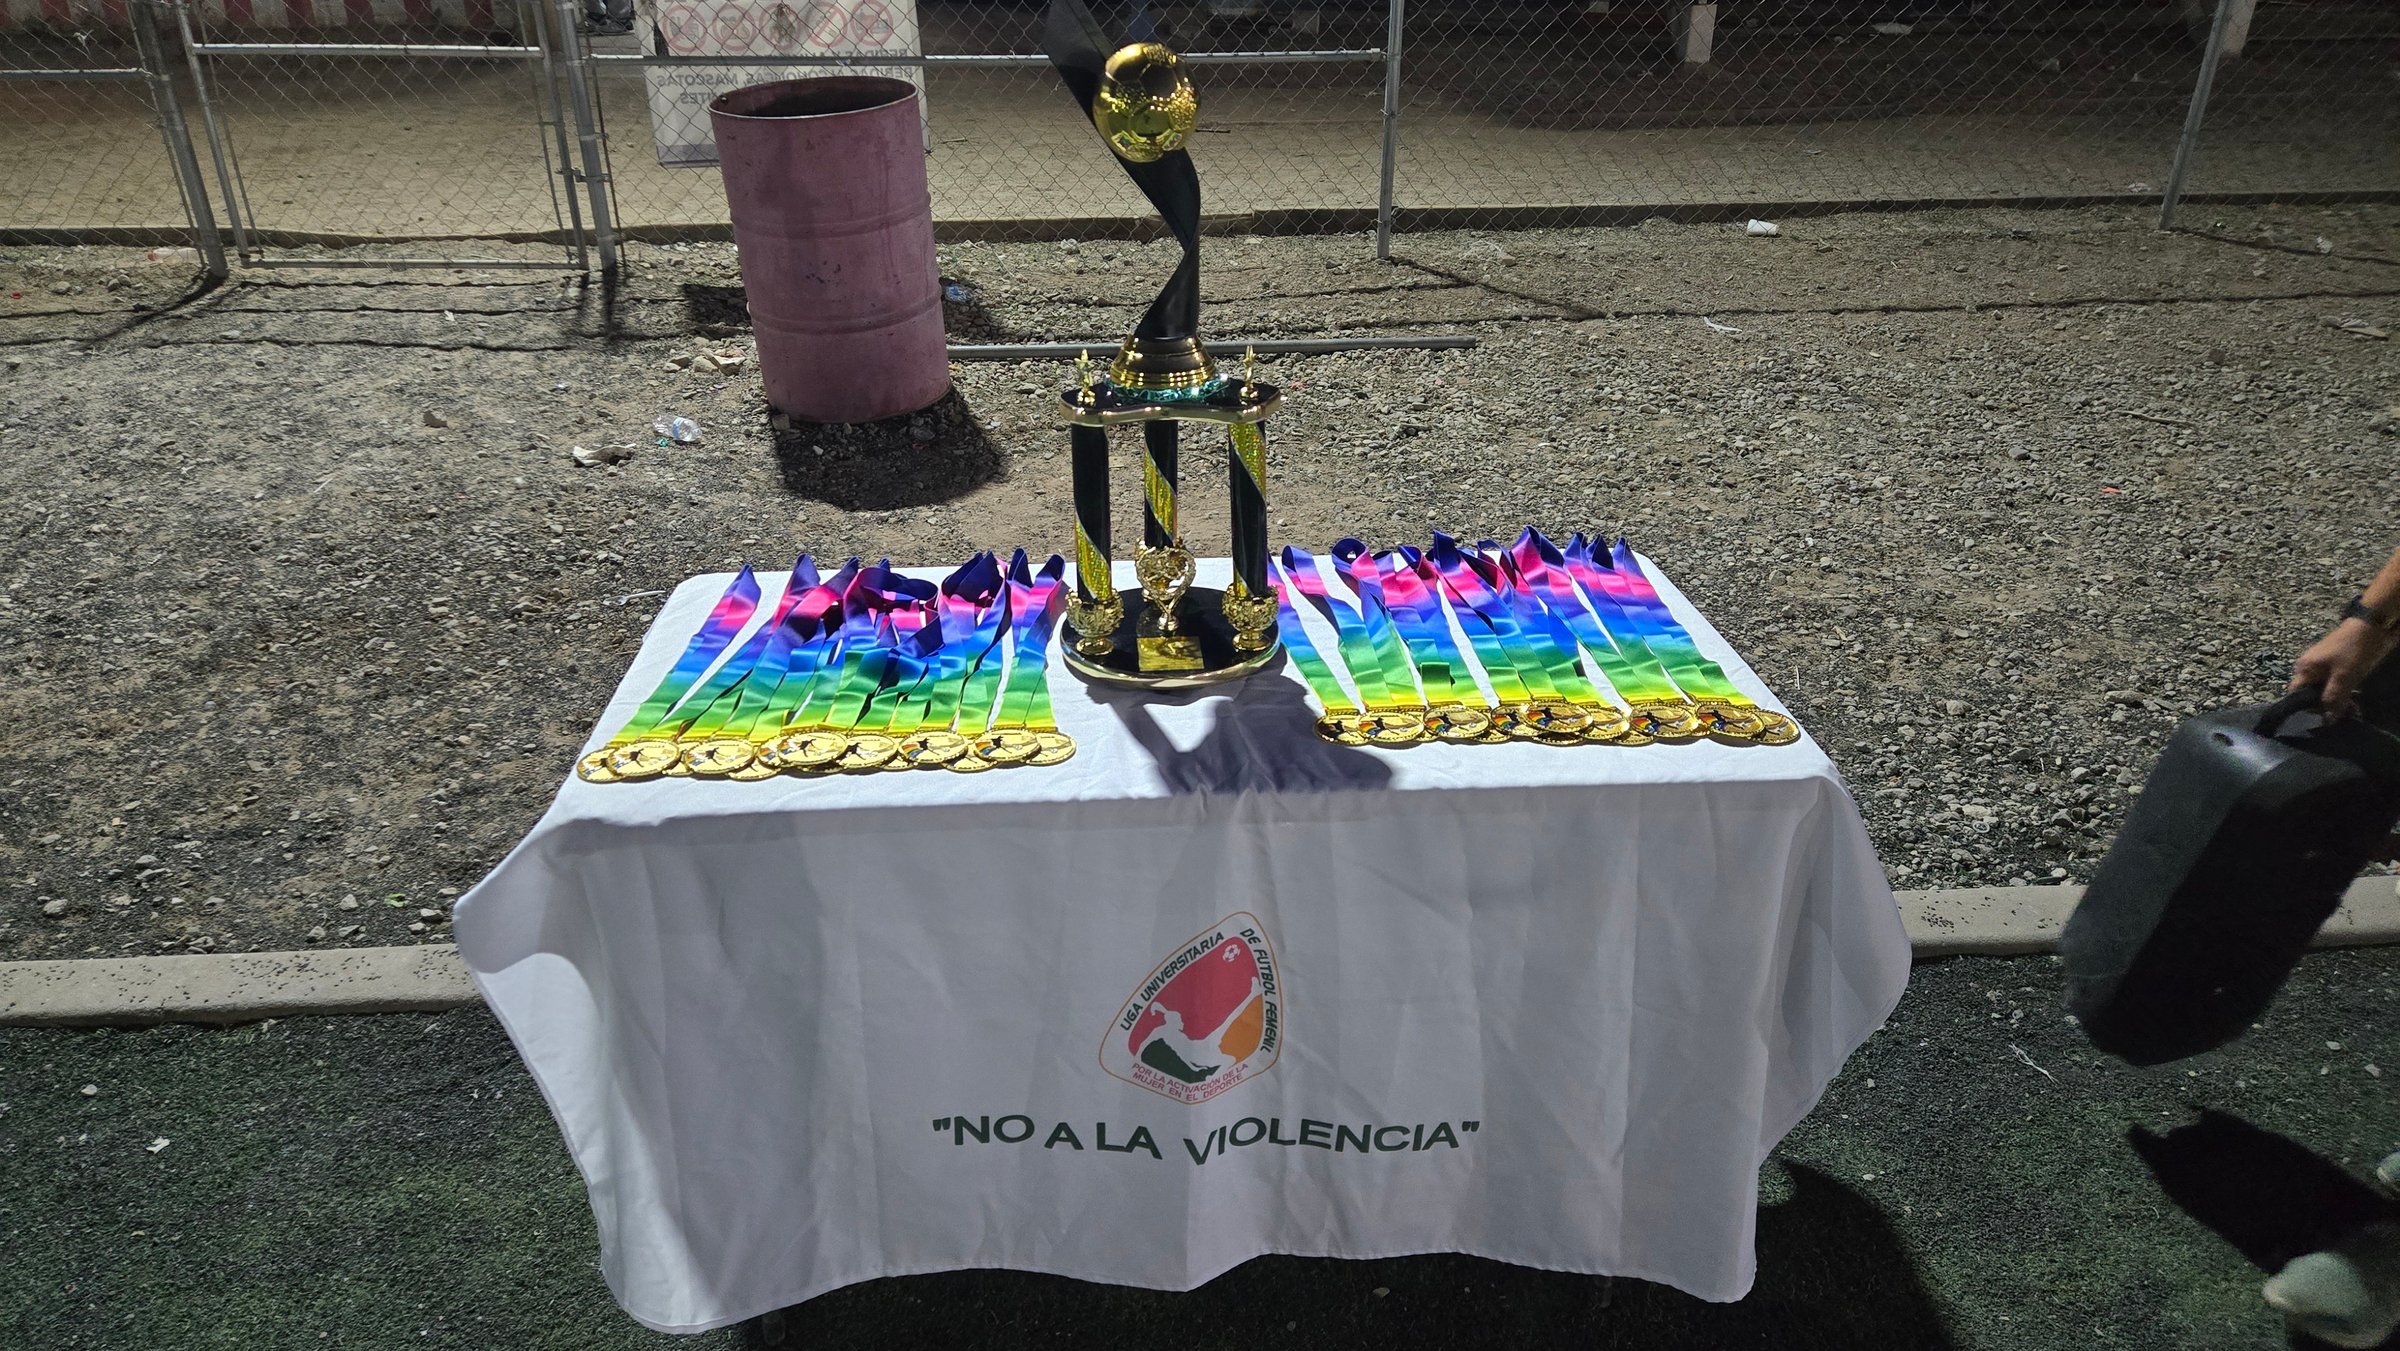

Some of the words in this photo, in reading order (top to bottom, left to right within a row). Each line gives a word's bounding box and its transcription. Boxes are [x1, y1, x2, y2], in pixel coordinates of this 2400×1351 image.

[1240, 927, 1262, 945] DE
[1140, 931, 1225, 1002] UNIVERSITARIA
[1253, 949, 1276, 997] FUTBOL
[1260, 1001, 1278, 1053] FEMENIL
[1131, 1062, 1152, 1077] POR
[1153, 1072, 1166, 1084] LA
[1222, 1069, 1235, 1081] DE
[1235, 1063, 1249, 1073] LA
[1132, 1072, 1165, 1091] MUJER
[1169, 1088, 1182, 1099] EN
[1186, 1093, 1199, 1102] EL
[1203, 1073, 1243, 1099] DEPORTE
[932, 1114, 1036, 1147] "NO
[1044, 1121, 1084, 1151] A
[1096, 1121, 1163, 1161] LA
[1183, 1116, 1481, 1167] VIOLENCIA"
